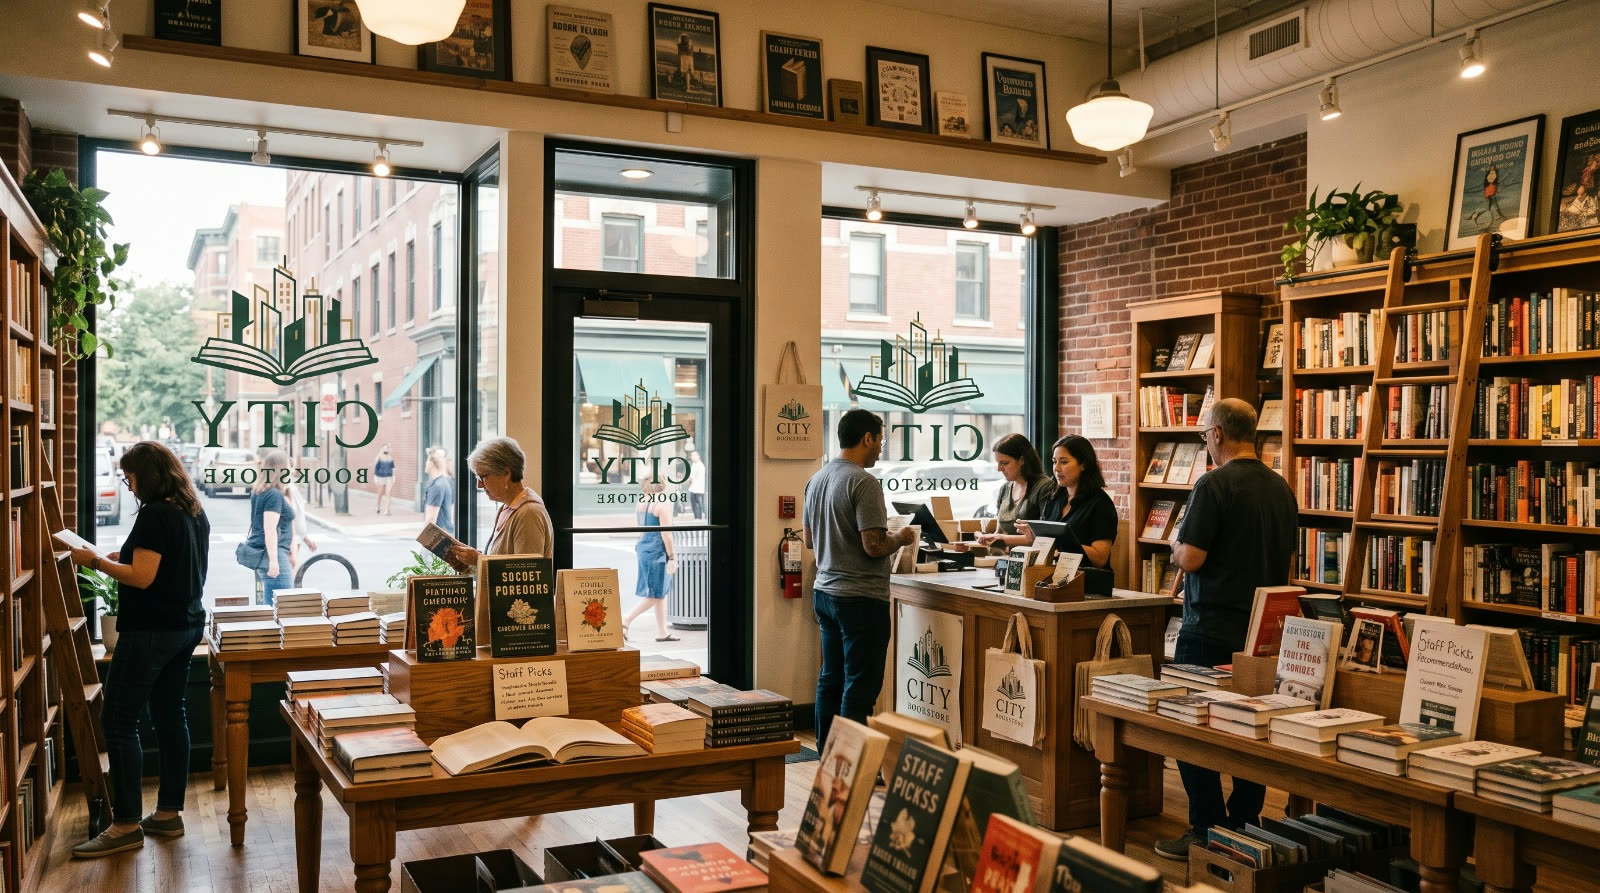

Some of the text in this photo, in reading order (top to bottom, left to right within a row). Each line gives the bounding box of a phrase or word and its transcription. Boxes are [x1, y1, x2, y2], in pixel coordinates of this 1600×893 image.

[776, 423, 811, 435] CITY
[1297, 640, 1310, 650] THE
[1417, 629, 1446, 652] Staff
[498, 666, 552, 680] Staff Picks
[907, 677, 951, 711] CITY
[907, 701, 950, 724] BOOKSTORE
[996, 698, 1026, 719] CITY
[902, 753, 945, 787] STAFF
[892, 770, 940, 815] PICKSS
